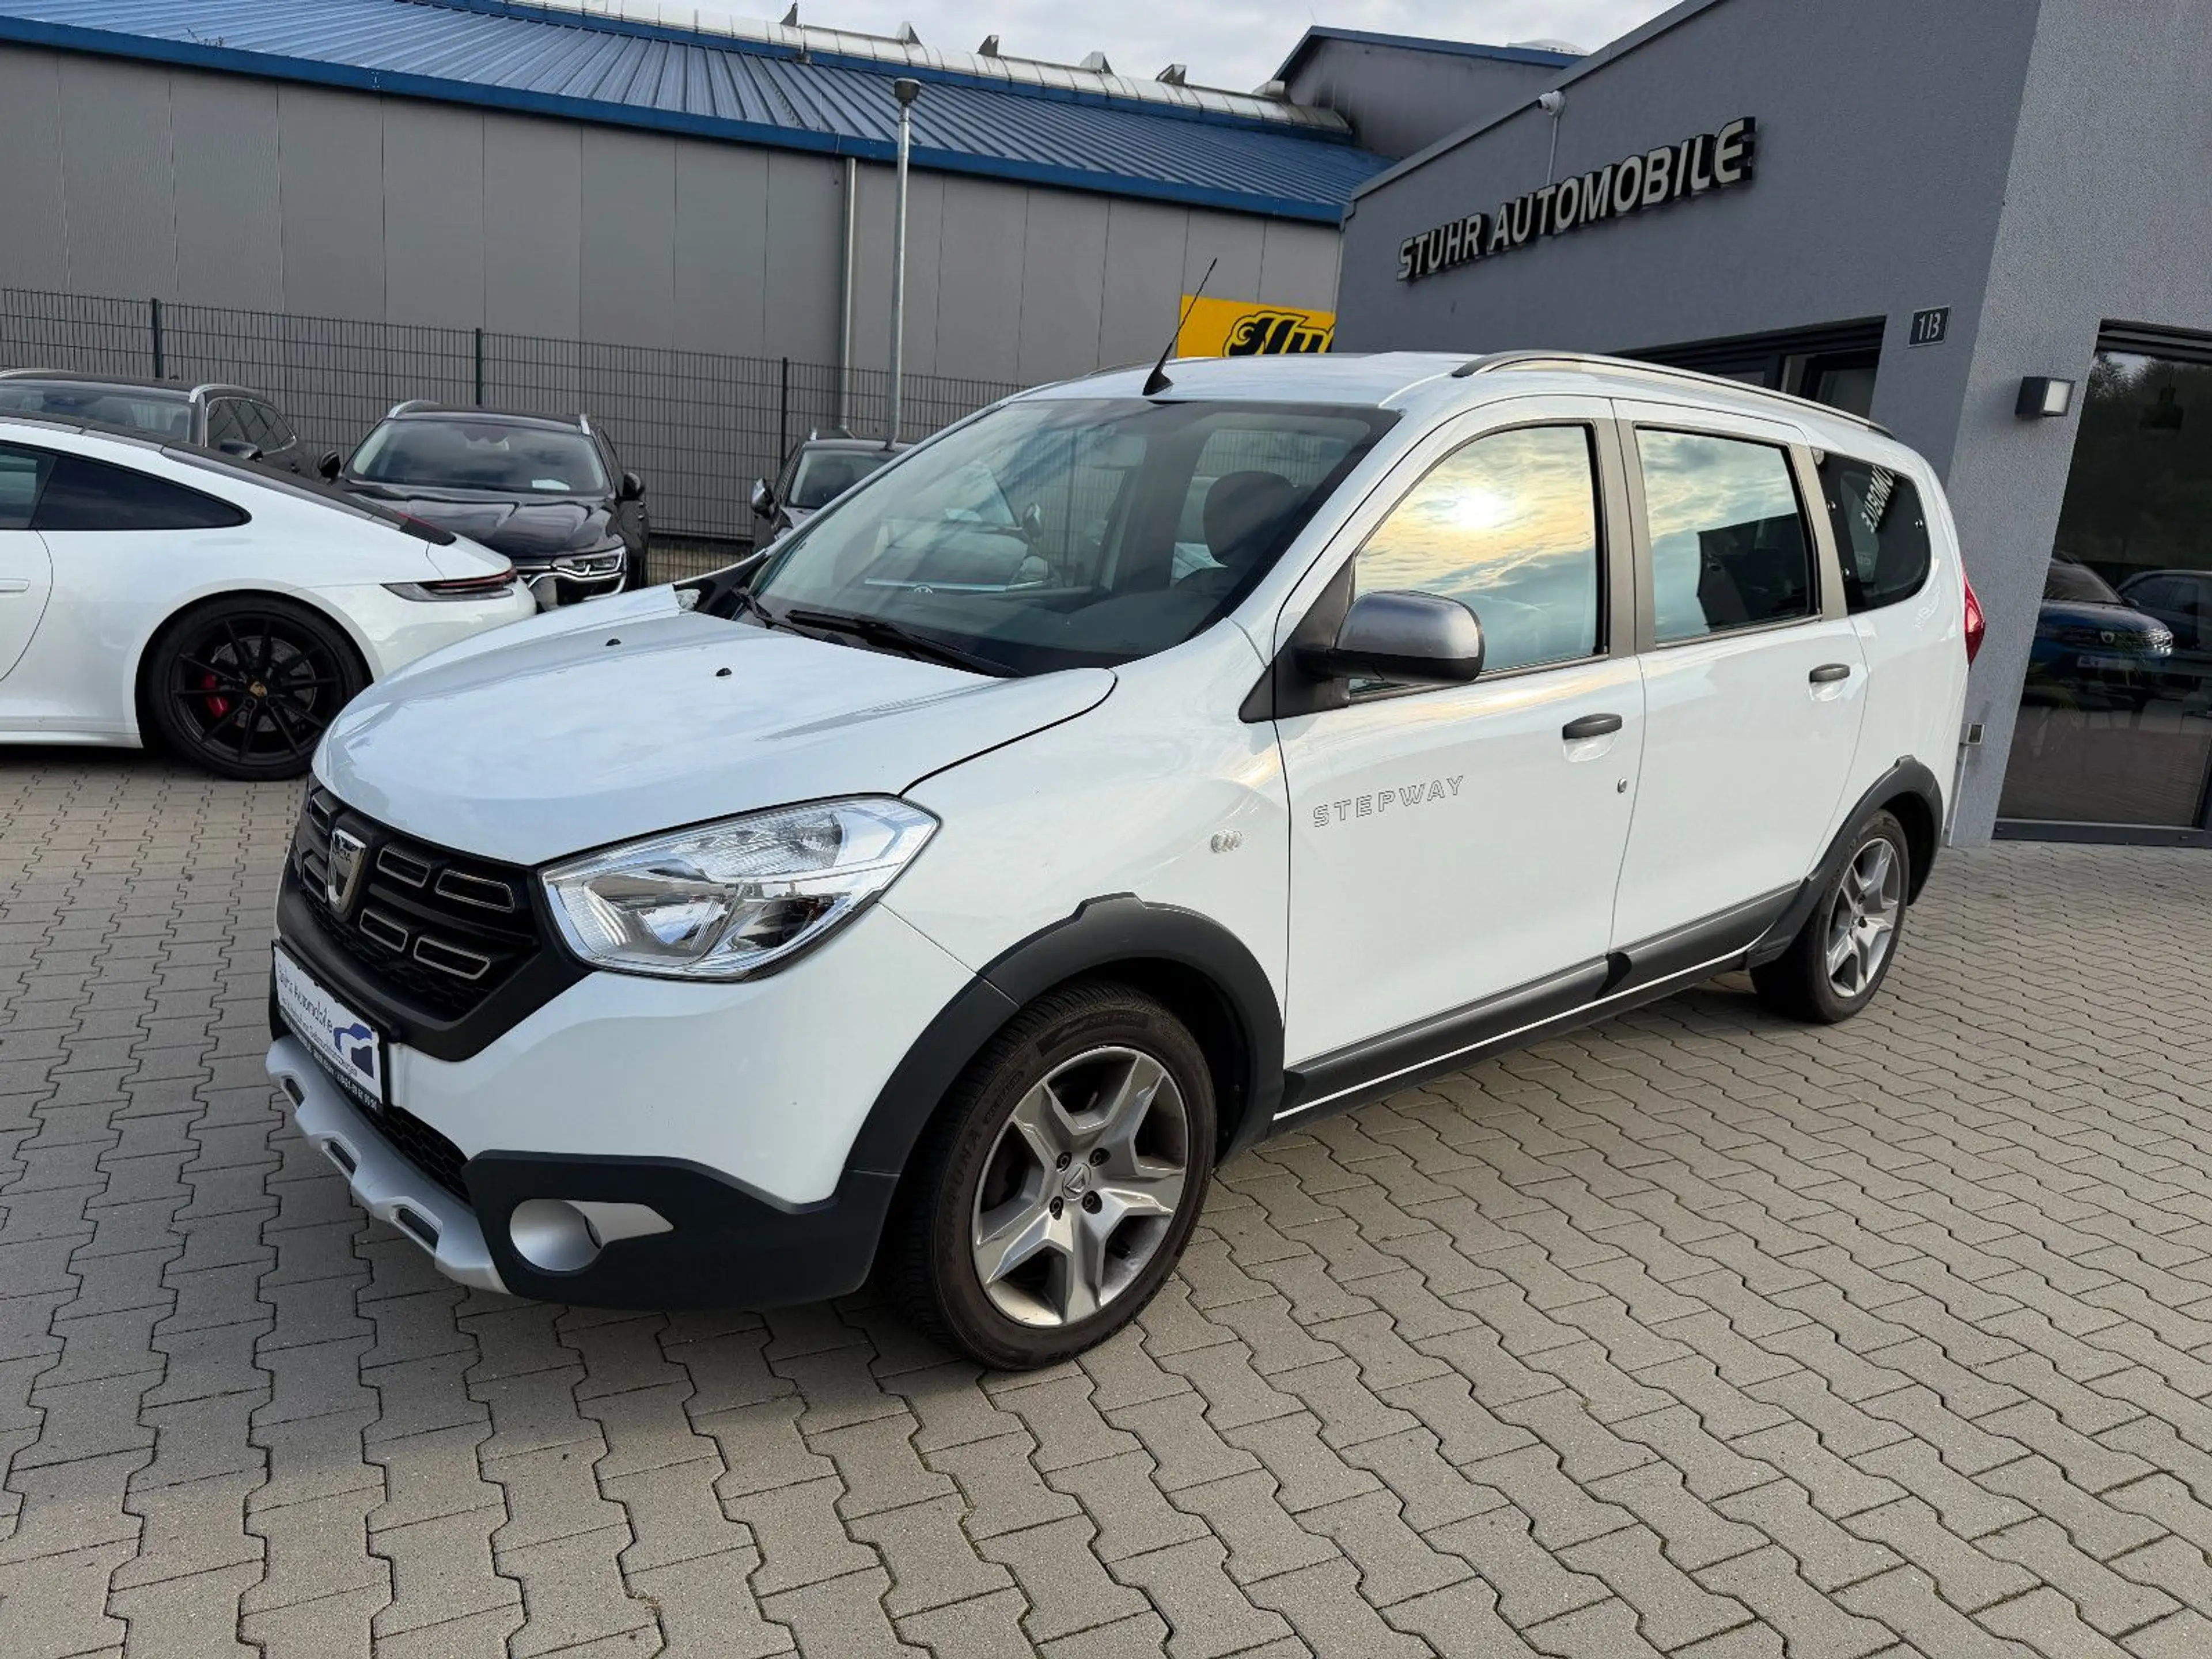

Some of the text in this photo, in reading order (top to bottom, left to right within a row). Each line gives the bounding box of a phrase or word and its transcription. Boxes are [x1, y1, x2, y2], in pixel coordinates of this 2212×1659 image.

[1397, 117, 1751, 281] STUHR AUTOMOBILE
[1313, 775, 1464, 828] STEPWAY
